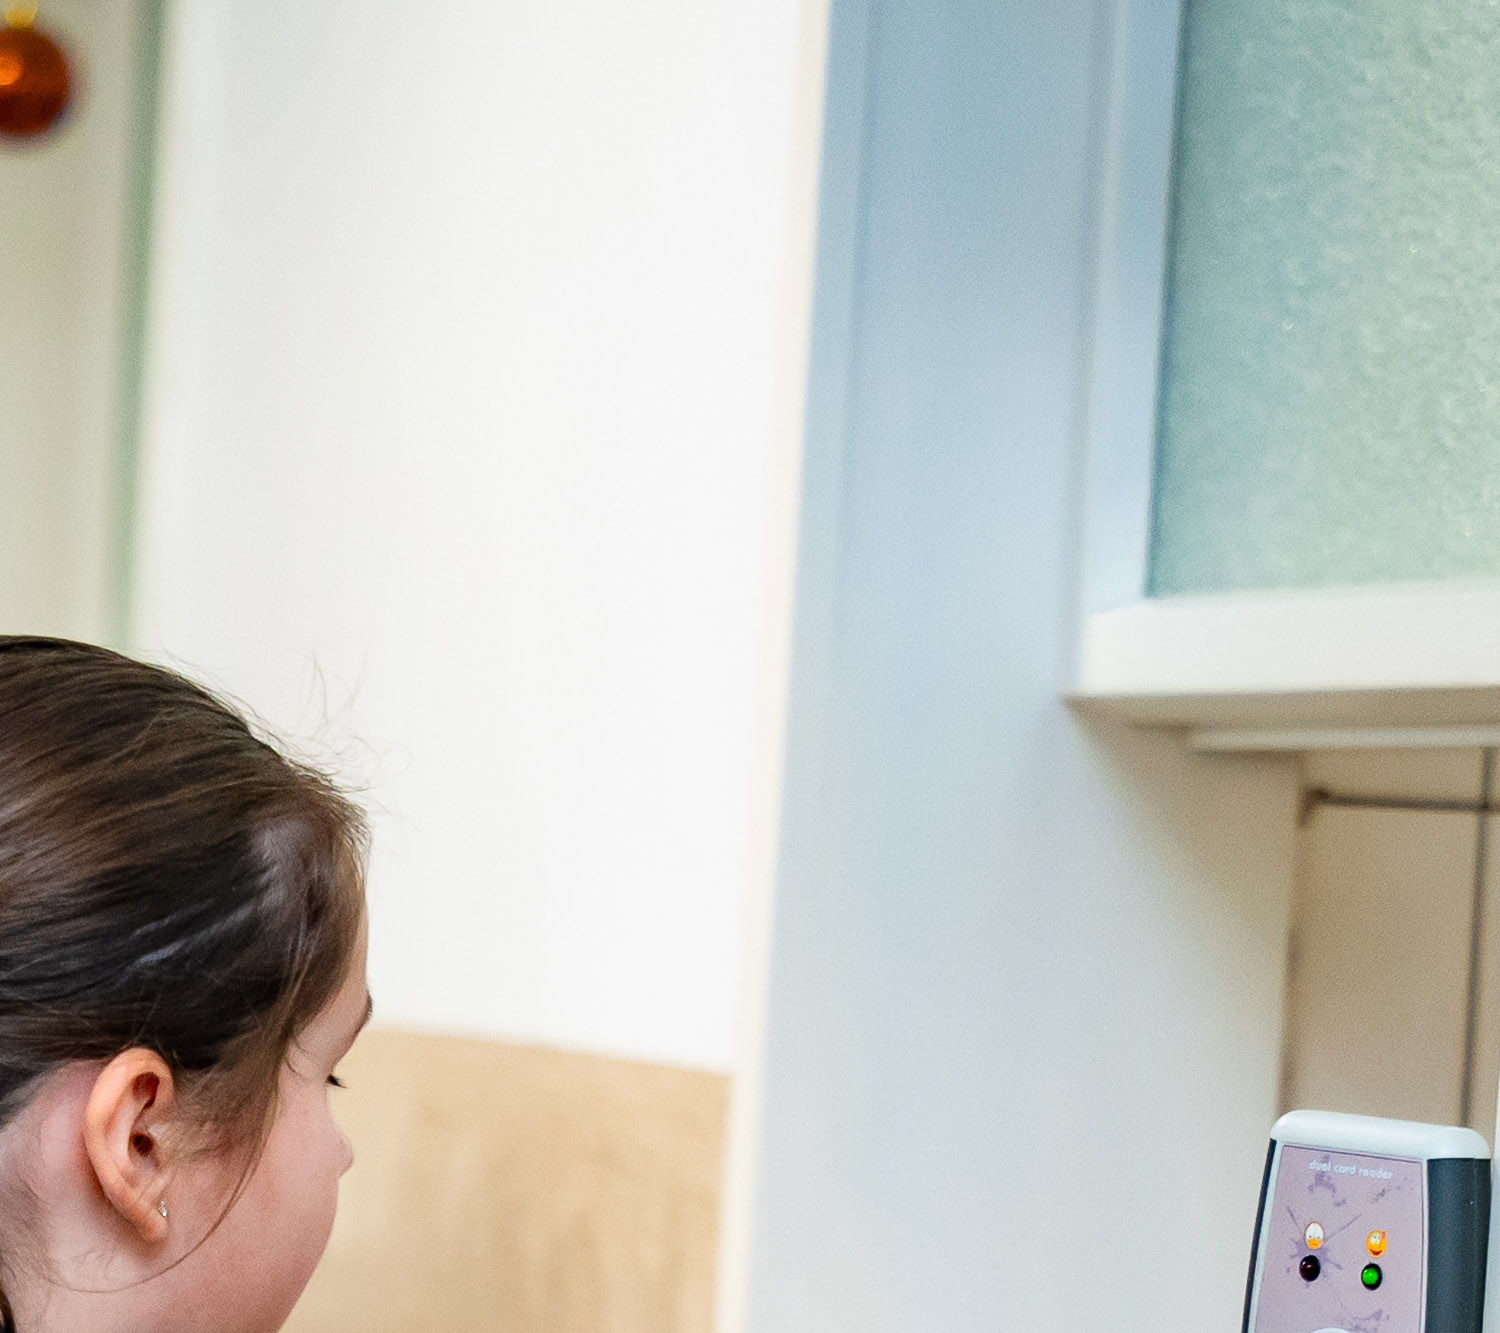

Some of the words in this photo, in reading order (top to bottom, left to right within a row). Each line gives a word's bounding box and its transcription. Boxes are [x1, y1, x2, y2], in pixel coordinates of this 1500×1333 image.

[1308, 1160, 1331, 1173] dual
[1334, 1164, 1356, 1176] card
[1358, 1167, 1394, 1180] reader
